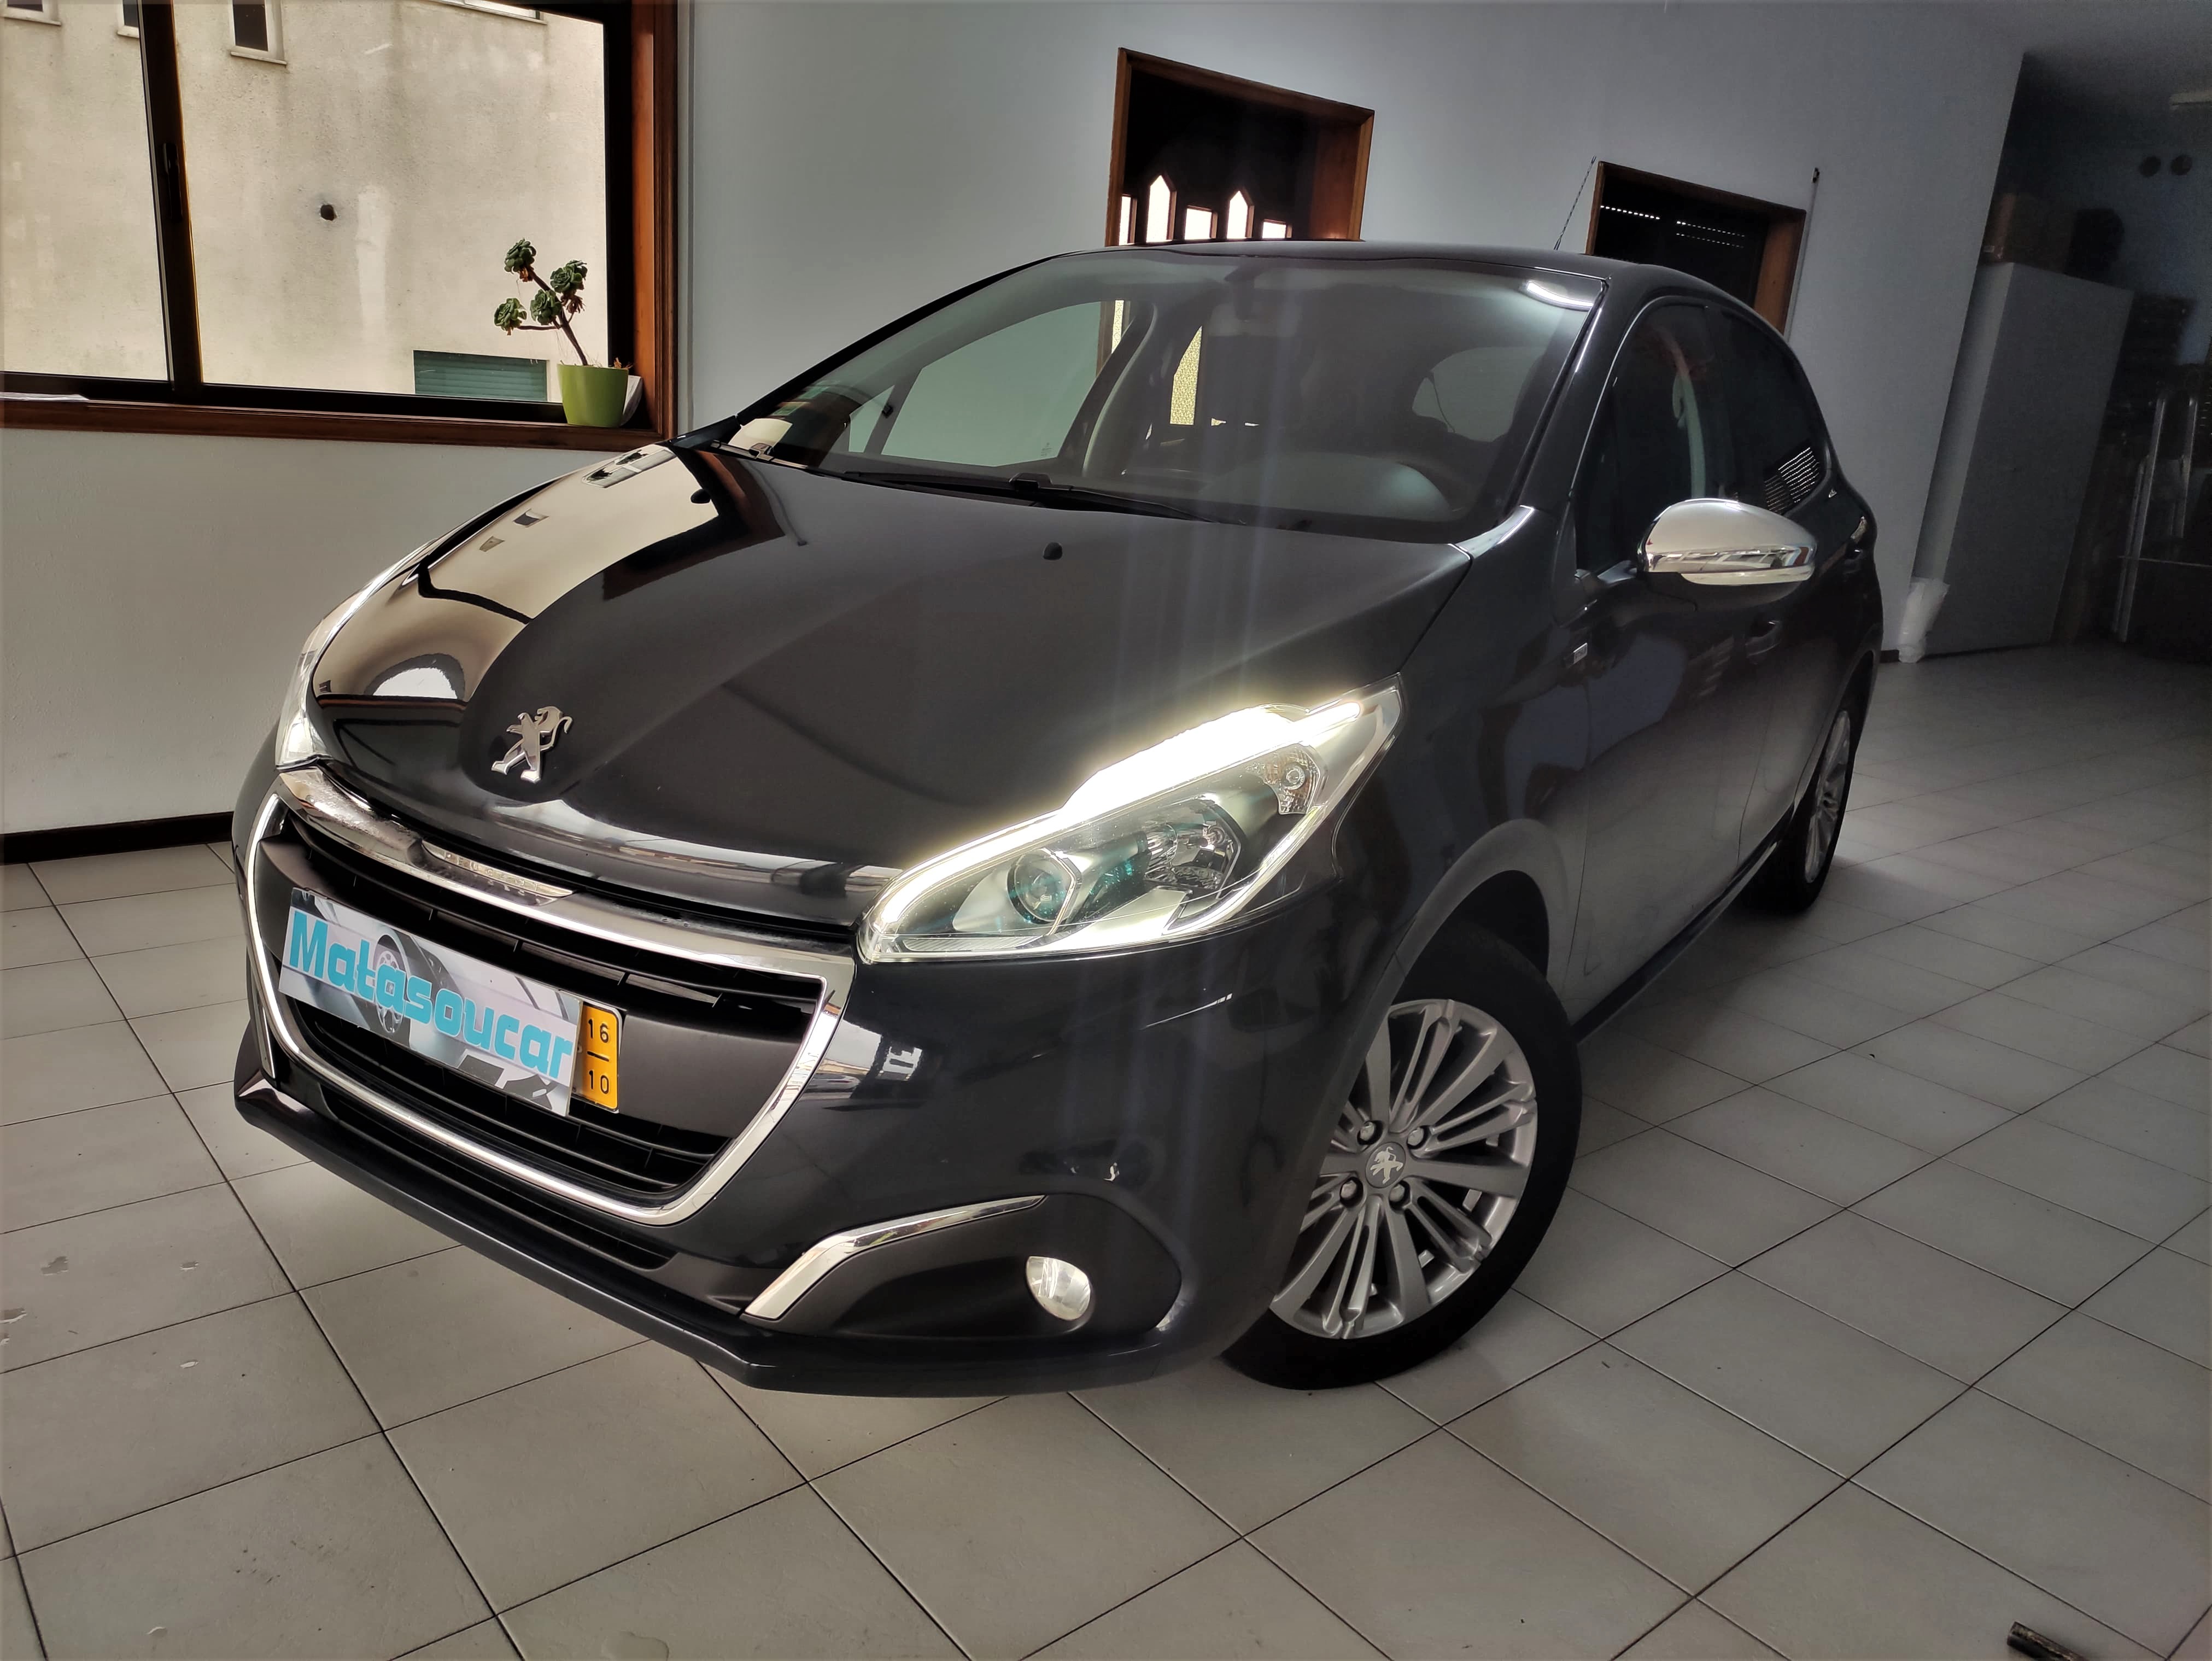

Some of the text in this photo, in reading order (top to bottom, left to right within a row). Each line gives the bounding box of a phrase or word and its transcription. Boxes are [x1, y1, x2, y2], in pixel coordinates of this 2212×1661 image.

[444, 851, 537, 891] PEUGEOT
[289, 911, 573, 1078] Matasoucar
[588, 1019, 609, 1043] 16
[589, 1070, 609, 1094] 10
